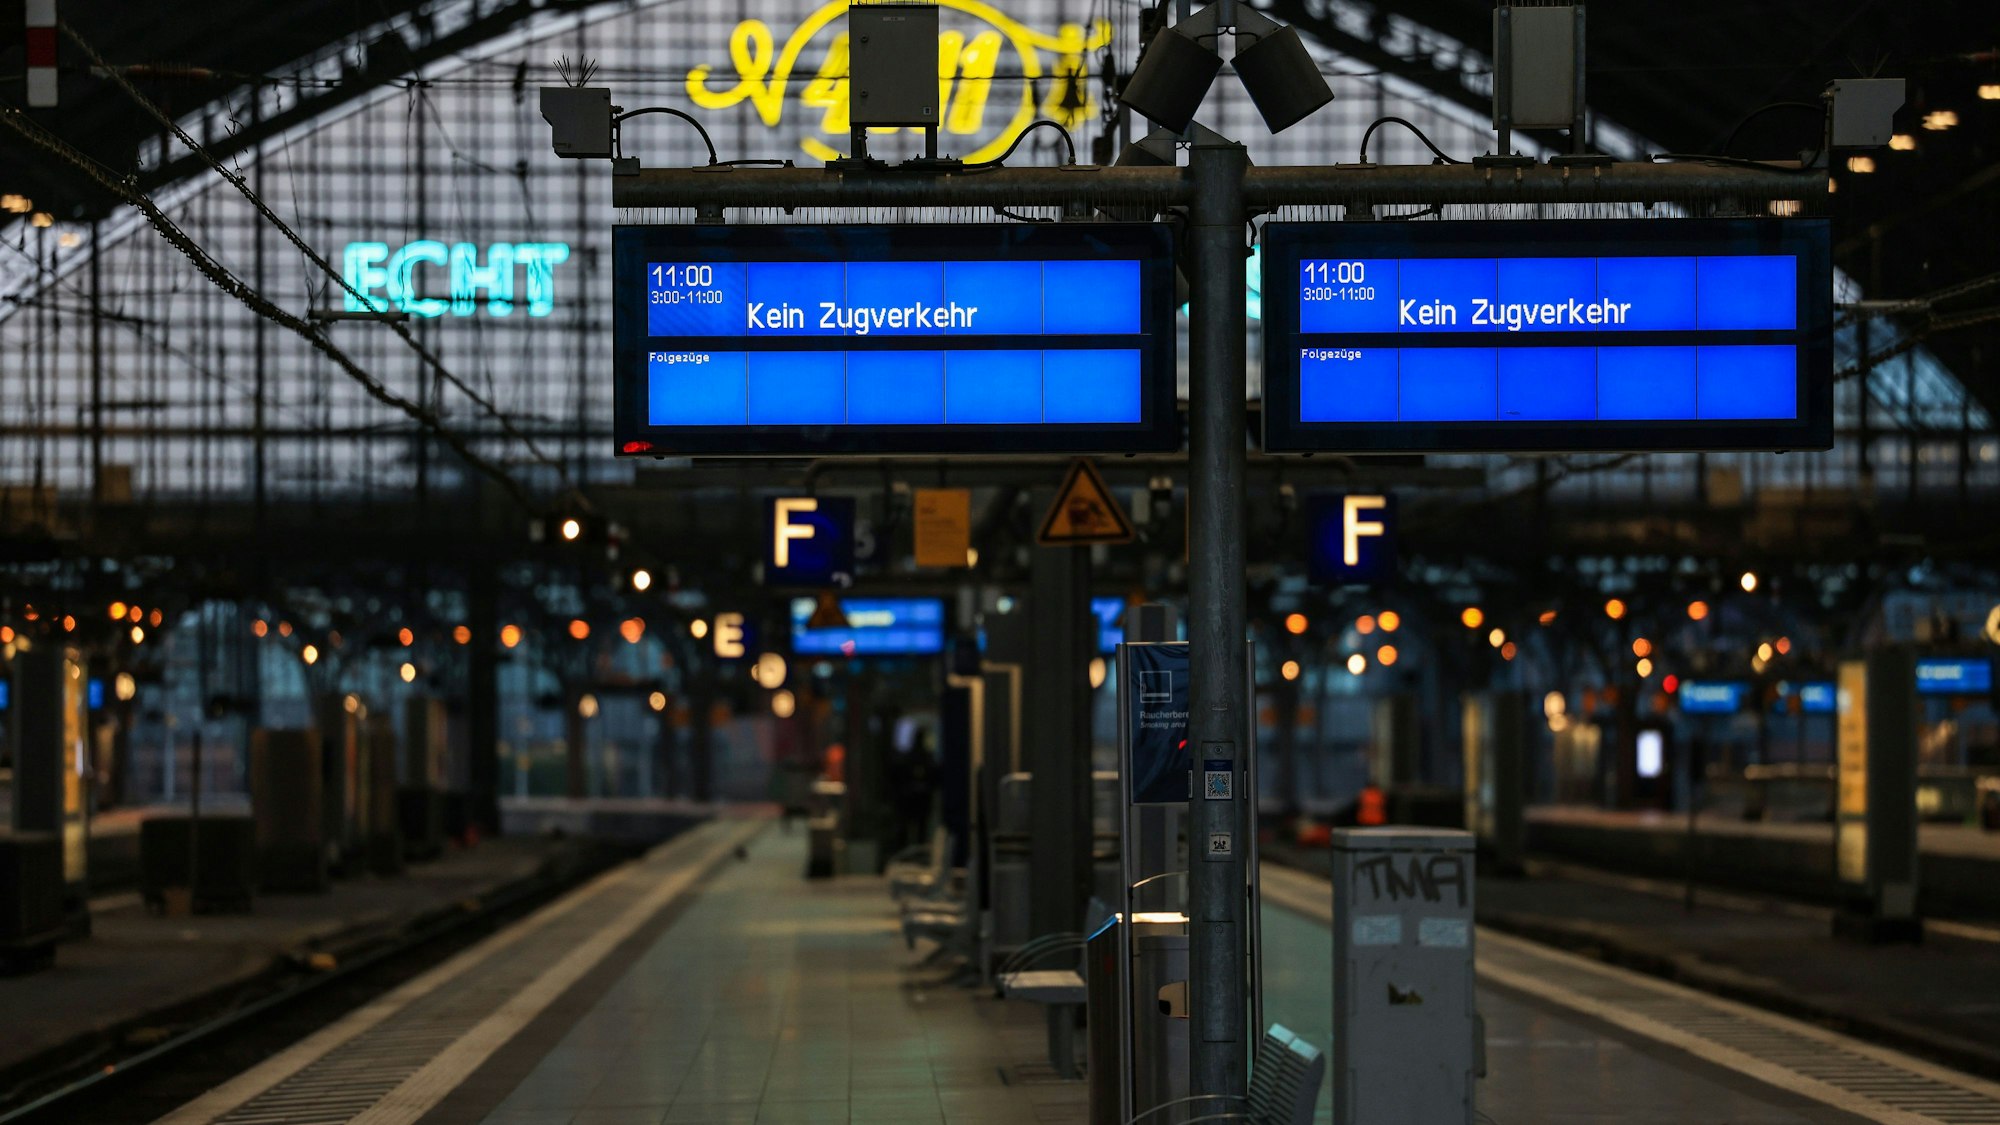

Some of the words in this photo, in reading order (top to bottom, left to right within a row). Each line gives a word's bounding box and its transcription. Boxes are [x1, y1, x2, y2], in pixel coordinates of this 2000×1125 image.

[343, 240, 570, 317] ECHT
[651, 265, 713, 287] 11:00
[1304, 261, 1365, 284] 11:00
[651, 290, 723, 304] 3:00-11:00
[1303, 286, 1375, 301] 3:00-11:00
[748, 302, 805, 329] Kein
[819, 302, 978, 335] Zugverkehr
[1400, 299, 1457, 326] Kein
[1471, 298, 1632, 331] Zugverkehr
[649, 352, 710, 365] Folgezüge
[1301, 349, 1362, 361] Folgezüge
[773, 496, 819, 568] F
[1343, 494, 1388, 567] F
[713, 611, 746, 659] E
[1140, 721, 1169, 729] Smoking
